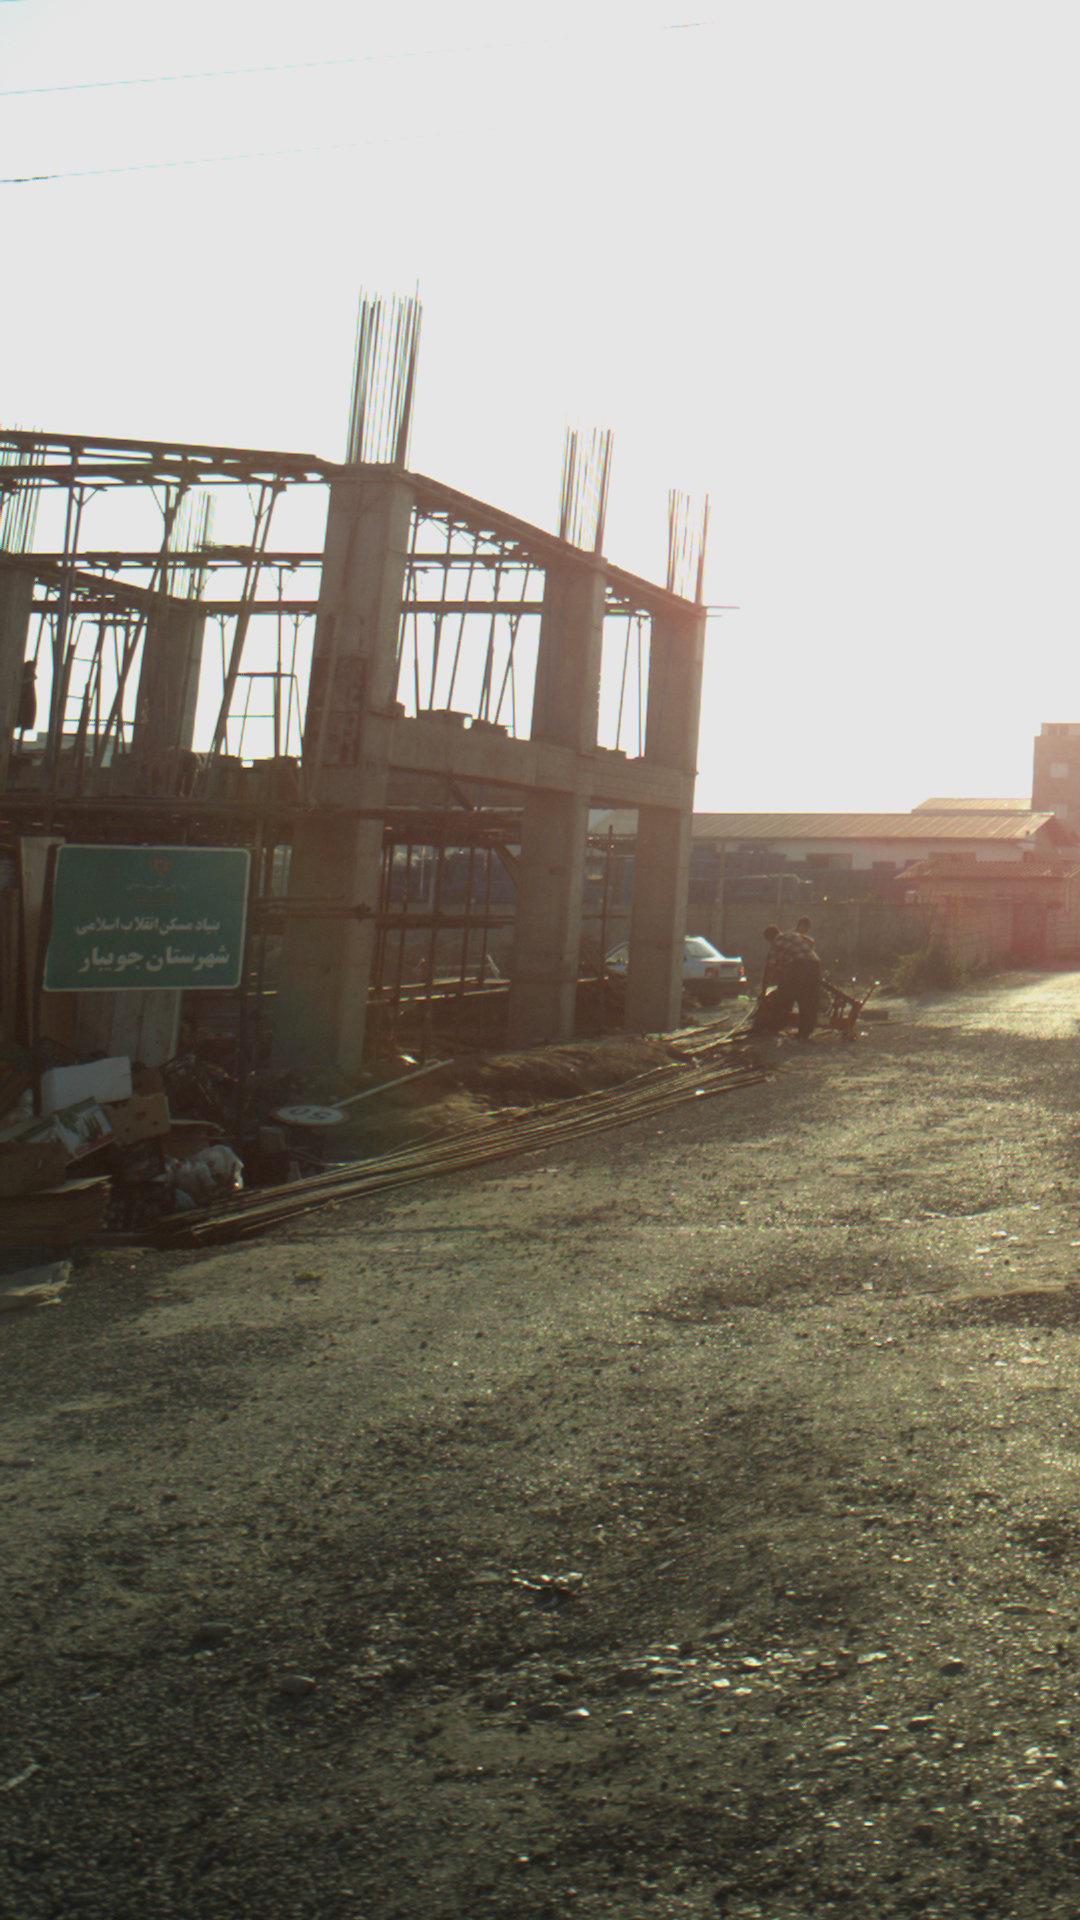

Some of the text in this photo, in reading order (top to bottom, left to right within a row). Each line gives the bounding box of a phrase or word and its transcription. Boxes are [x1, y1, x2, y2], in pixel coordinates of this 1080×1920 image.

[76, 916, 221, 936] بنیاد مسکن انقلاب اسلامی
[78, 944, 231, 973] شهرستان جویبار
